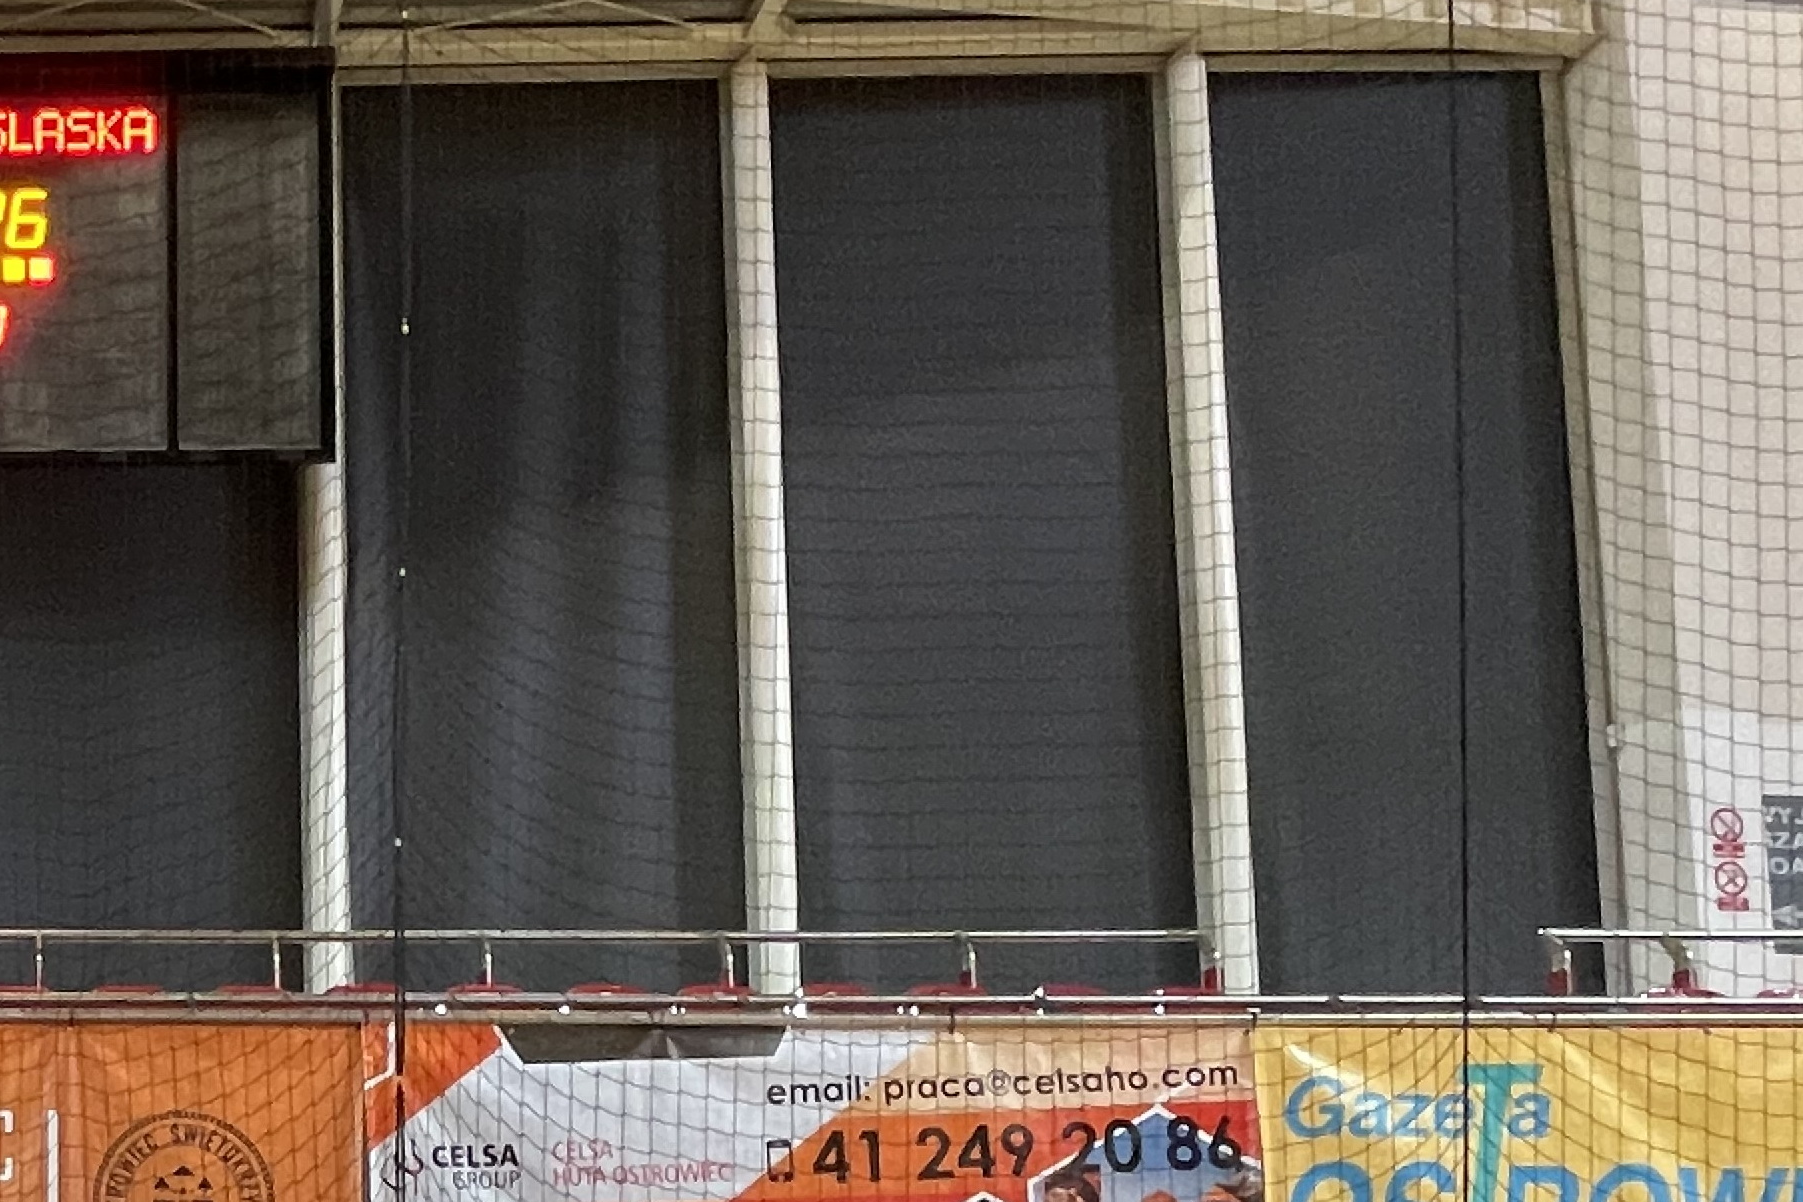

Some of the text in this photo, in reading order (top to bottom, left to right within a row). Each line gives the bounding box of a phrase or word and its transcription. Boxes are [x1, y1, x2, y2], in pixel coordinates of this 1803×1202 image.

[767, 1063, 1239, 1106] email: praca@celsaho.com
[432, 1142, 520, 1168] CELSA
[552, 1139, 614, 1162] CELSA
[812, 1114, 1244, 1184] 41 249 20 86
[452, 1169, 523, 1190] GROUP
[552, 1161, 740, 1186] HUTA OSTROWIEC
